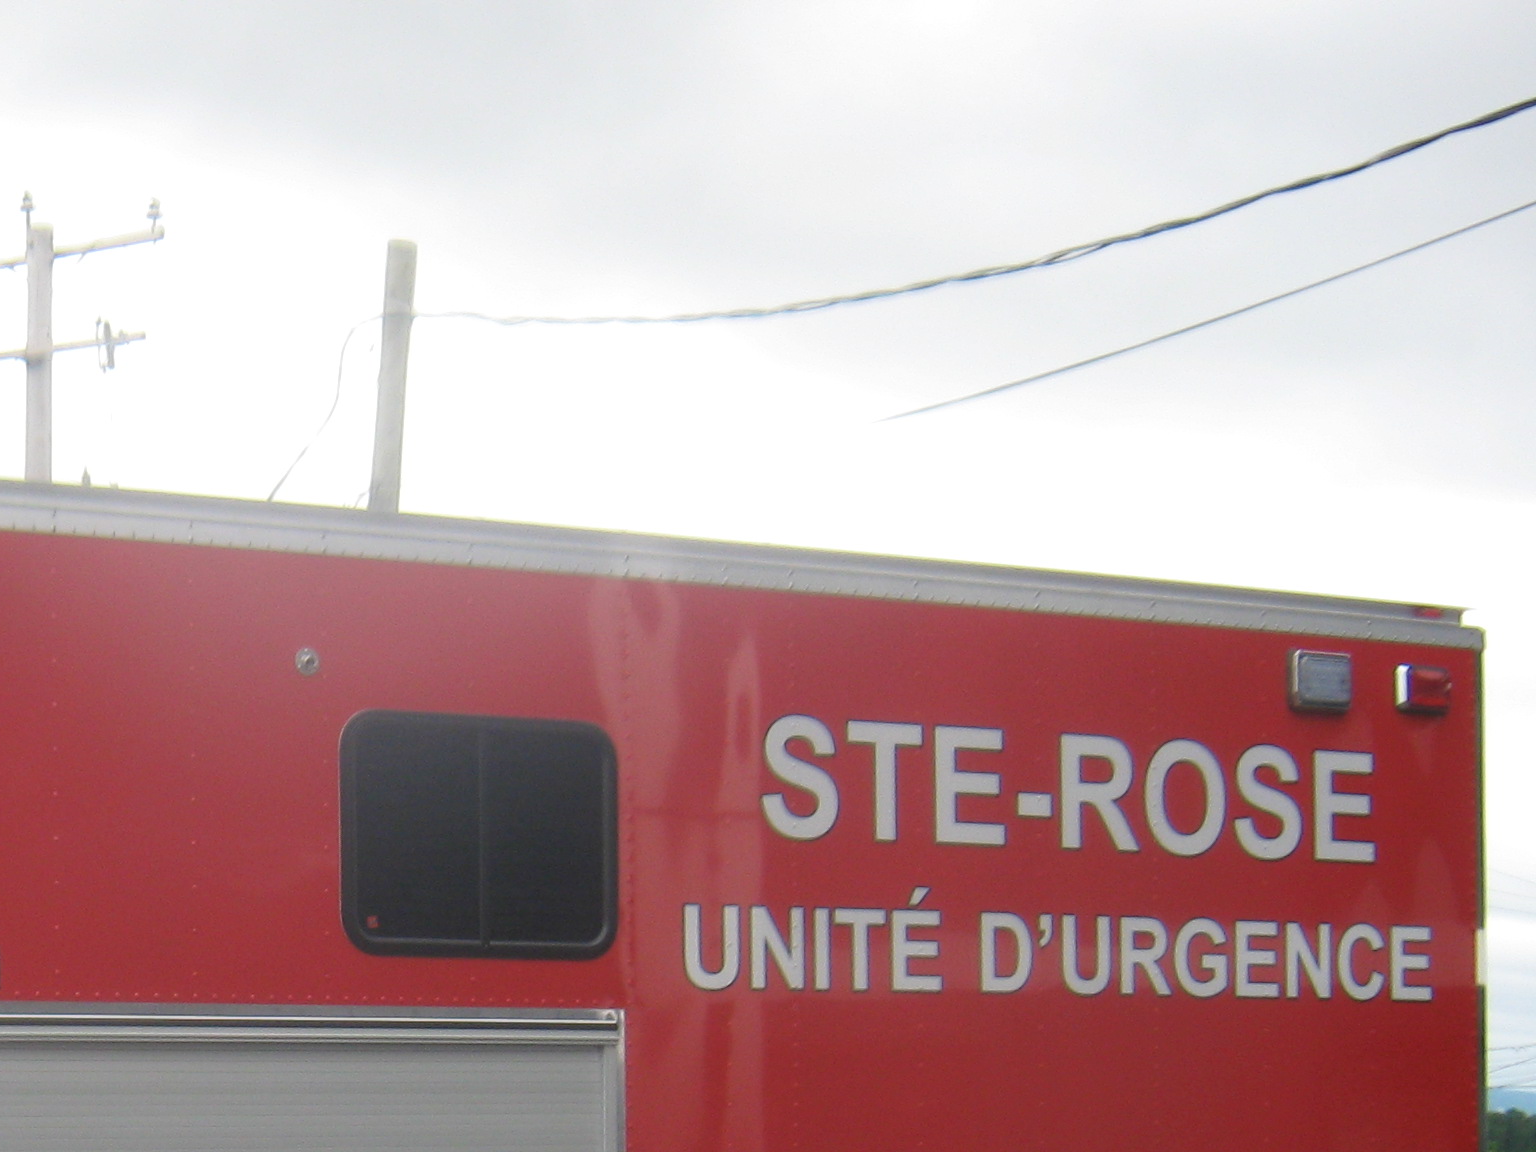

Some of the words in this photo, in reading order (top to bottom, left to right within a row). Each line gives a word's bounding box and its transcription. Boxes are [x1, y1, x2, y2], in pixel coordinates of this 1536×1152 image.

[759, 713, 1378, 864] STE-ROSE
[682, 886, 944, 993] UNITÉ
[978, 911, 1435, 1003] D'URGENCE
